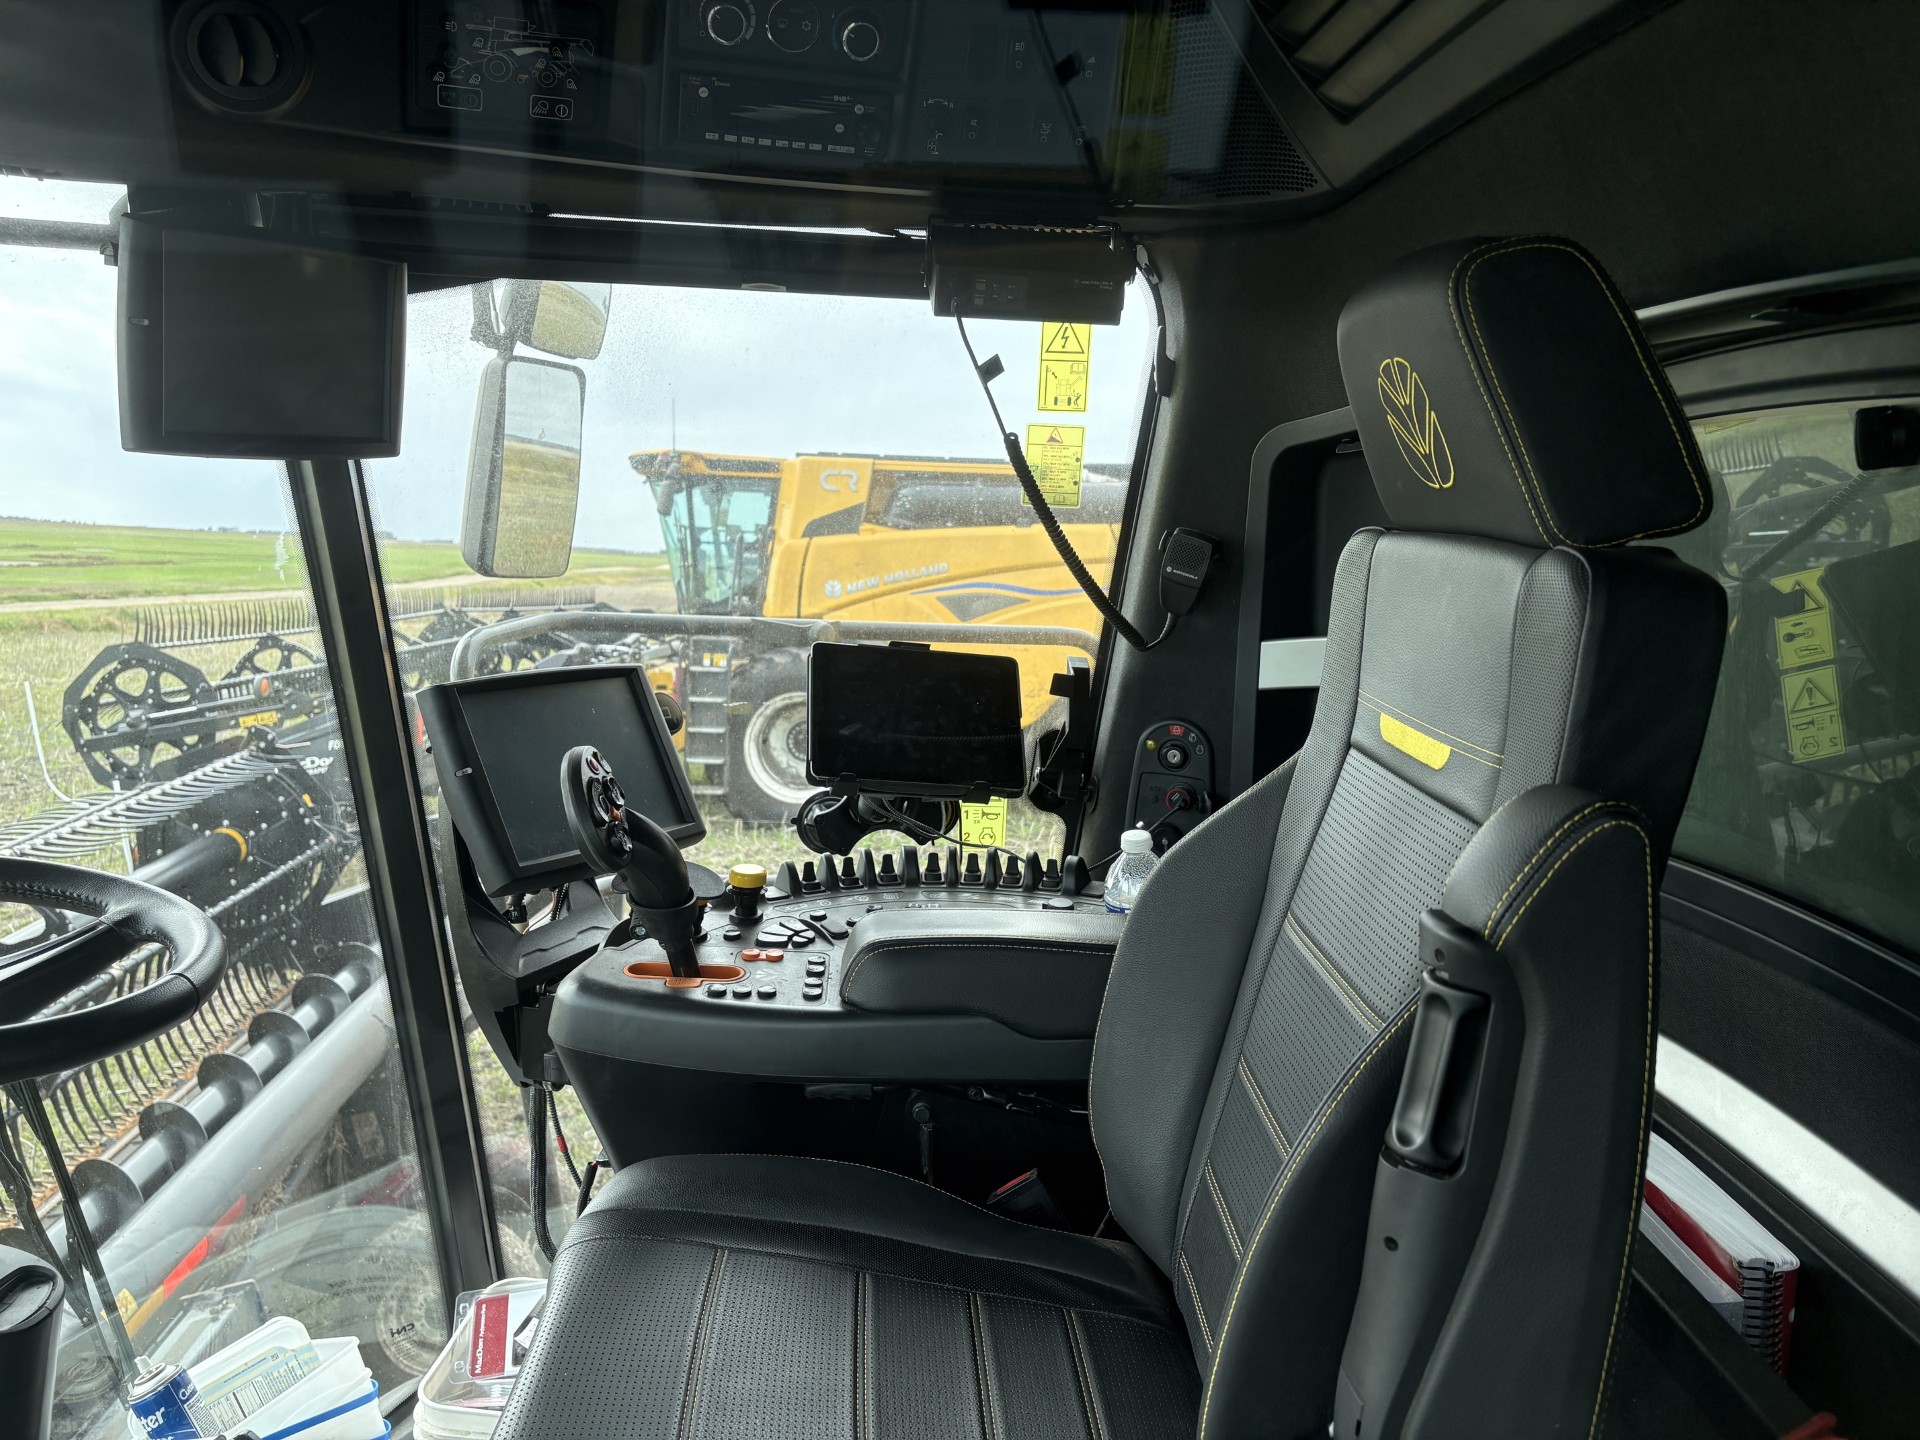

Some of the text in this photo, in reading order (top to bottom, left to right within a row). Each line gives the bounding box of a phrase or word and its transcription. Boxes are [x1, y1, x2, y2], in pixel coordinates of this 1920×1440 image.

[819, 469, 859, 493] CR
[847, 563, 949, 594] NEW HOLLAND
[1172, 569, 1198, 580] MOTOROLA
[963, 810, 969, 820] 1
[963, 832, 971, 842] 2
[474, 1338, 483, 1373] MacDon
